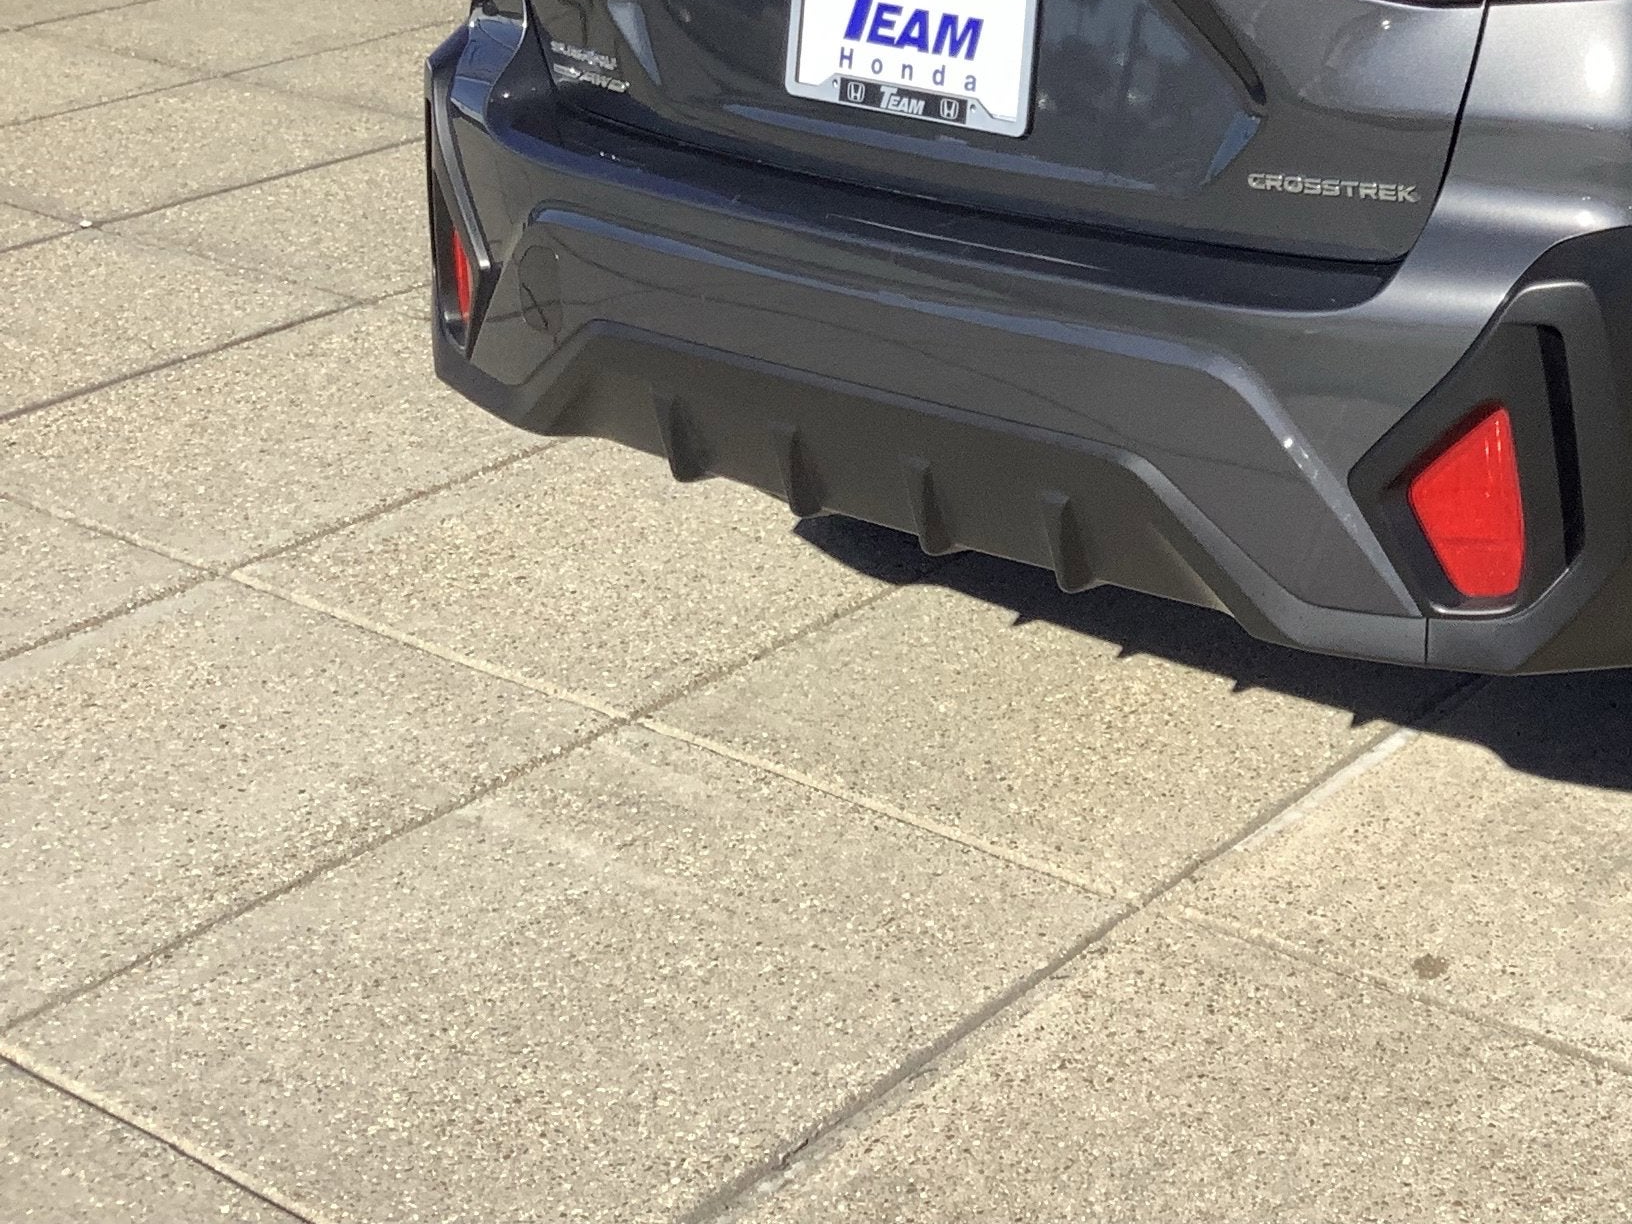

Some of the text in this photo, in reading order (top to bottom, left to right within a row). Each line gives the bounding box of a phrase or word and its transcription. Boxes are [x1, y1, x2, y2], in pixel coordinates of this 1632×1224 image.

[838, 46, 977, 92] Honda
[879, 85, 926, 116] TEAM
[1247, 172, 1421, 203] CROSSTREK
